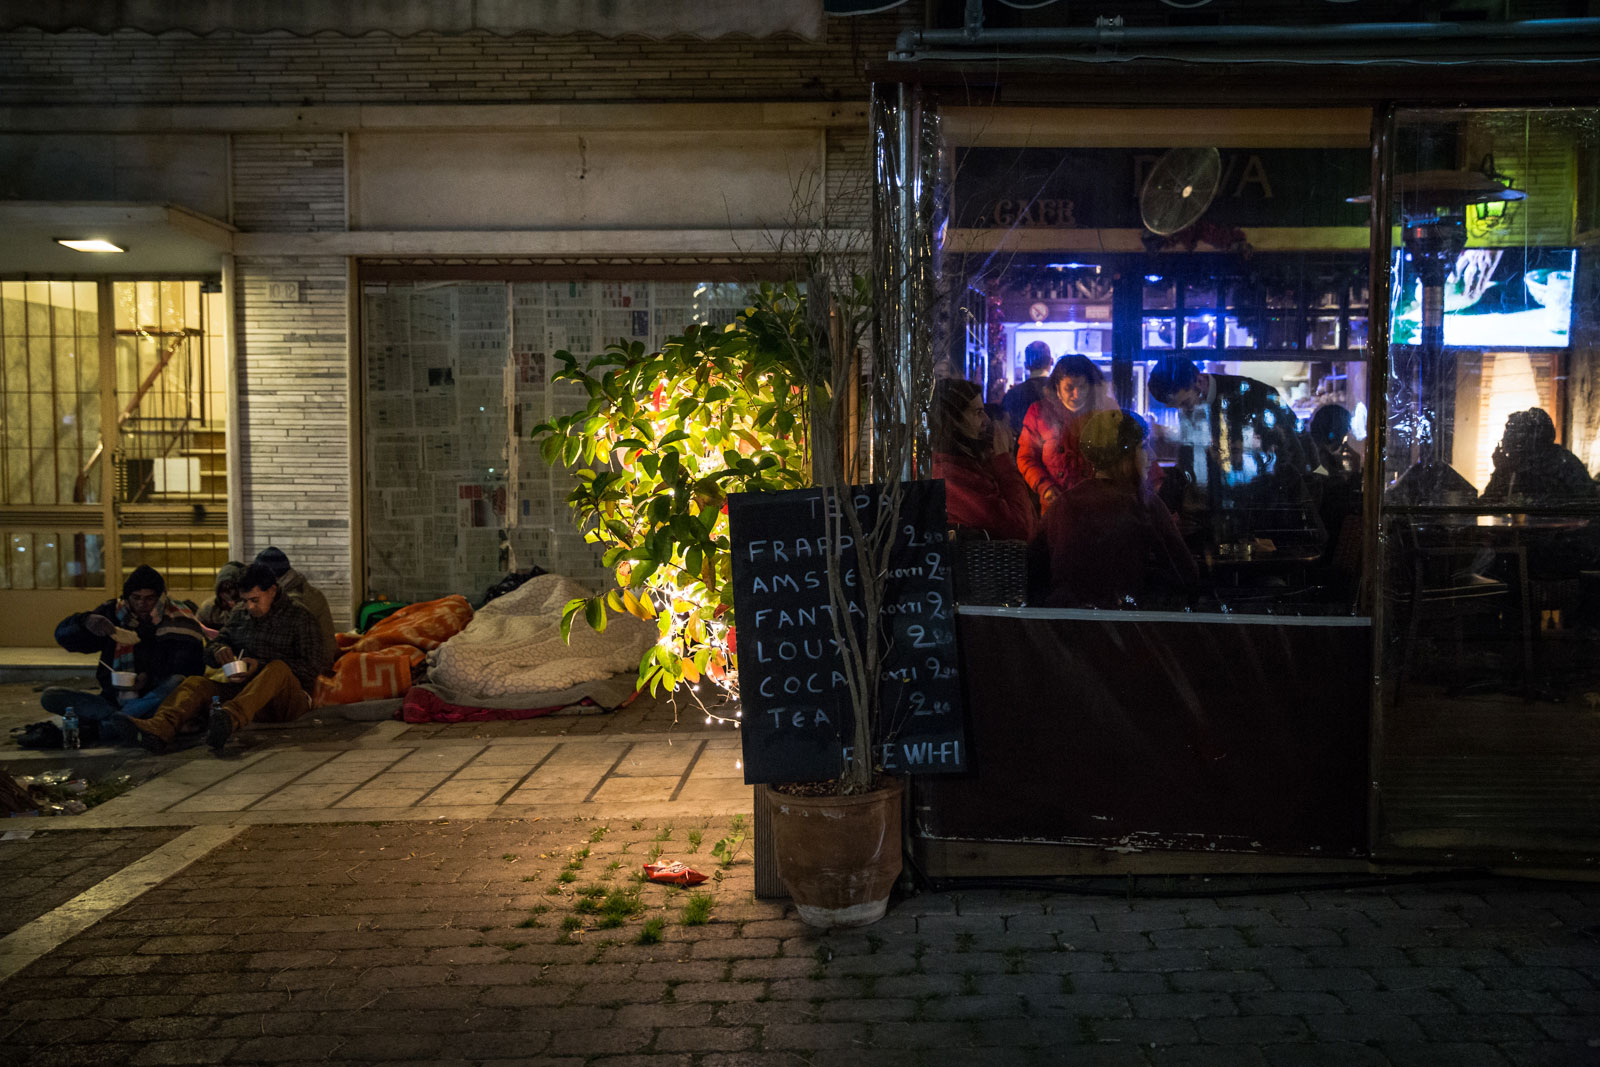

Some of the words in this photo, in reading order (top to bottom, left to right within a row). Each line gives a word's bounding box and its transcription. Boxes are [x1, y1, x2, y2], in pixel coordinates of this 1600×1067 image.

[748, 534, 868, 563] FRAPP
[759, 670, 850, 698] COCA
[767, 707, 831, 729] TEA
[903, 740, 960, 766] WI-FI
